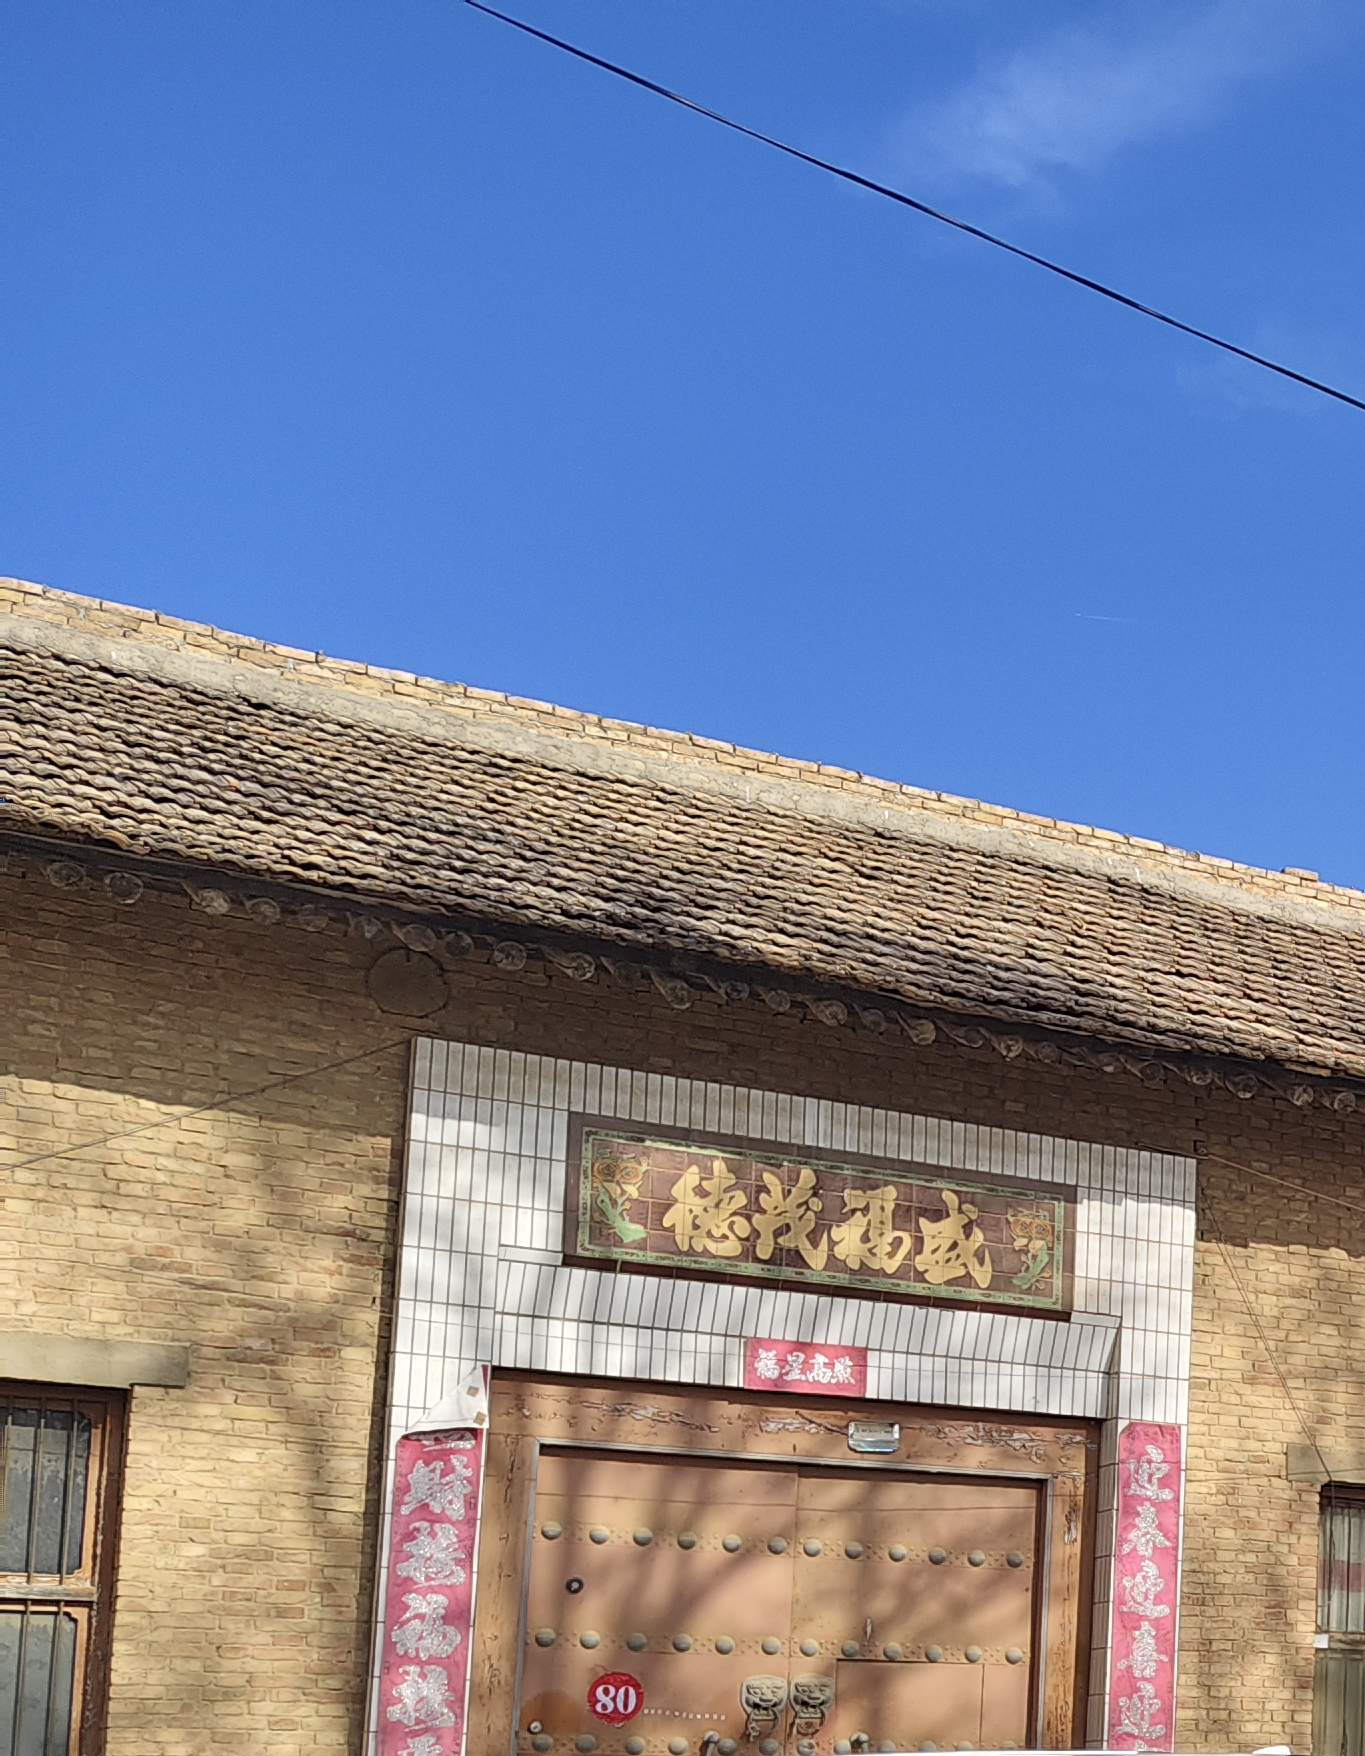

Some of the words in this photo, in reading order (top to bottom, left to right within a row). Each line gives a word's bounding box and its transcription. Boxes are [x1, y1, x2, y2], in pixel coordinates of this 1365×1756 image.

[755, 1348, 856, 1385] 福星高照
[1115, 1445, 1176, 1751] 迎春迎喜迎
[595, 1685, 636, 1714] 80
